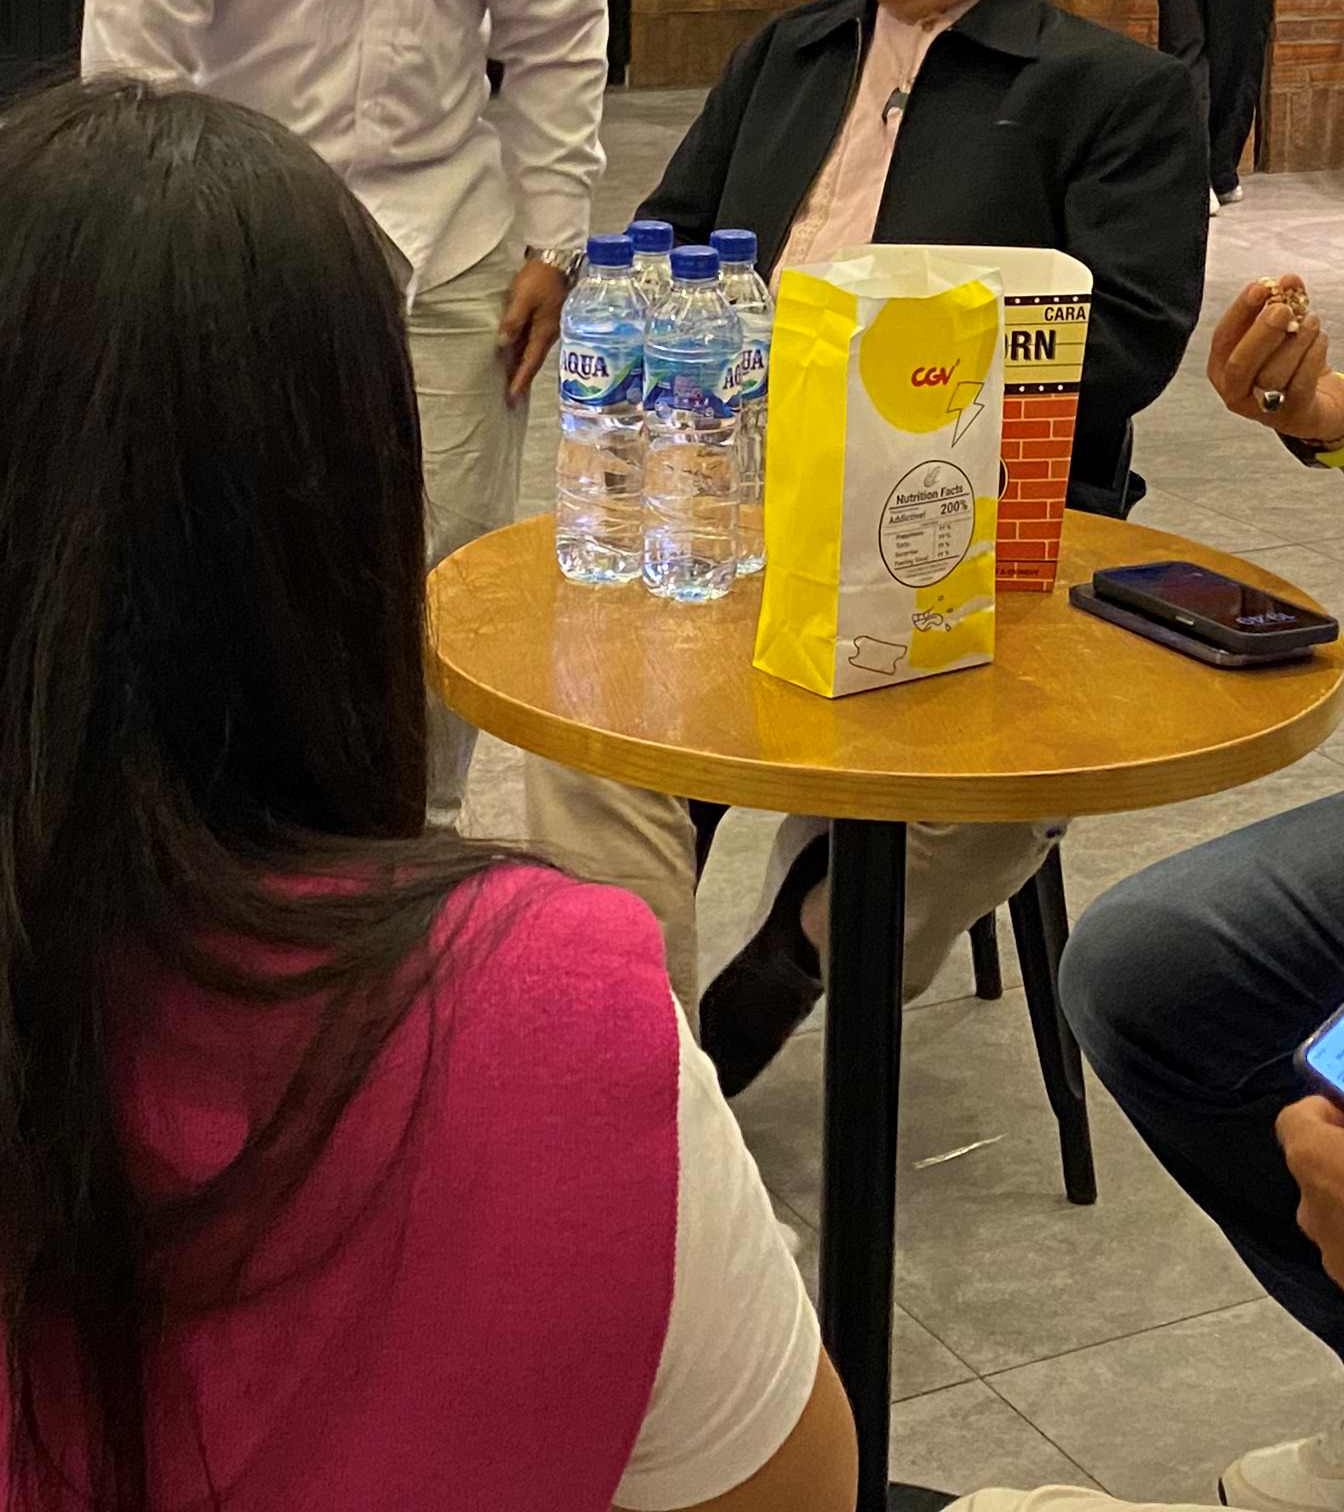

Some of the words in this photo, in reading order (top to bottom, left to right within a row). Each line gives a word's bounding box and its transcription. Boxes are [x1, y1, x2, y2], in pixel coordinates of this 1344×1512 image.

[1043, 306, 1087, 322] CARA
[1005, 329, 1057, 362] RN
[911, 358, 961, 387] CGV
[895, 490, 939, 505] Nutrition
[940, 484, 964, 498] Facts
[940, 499, 969, 515] 200%
